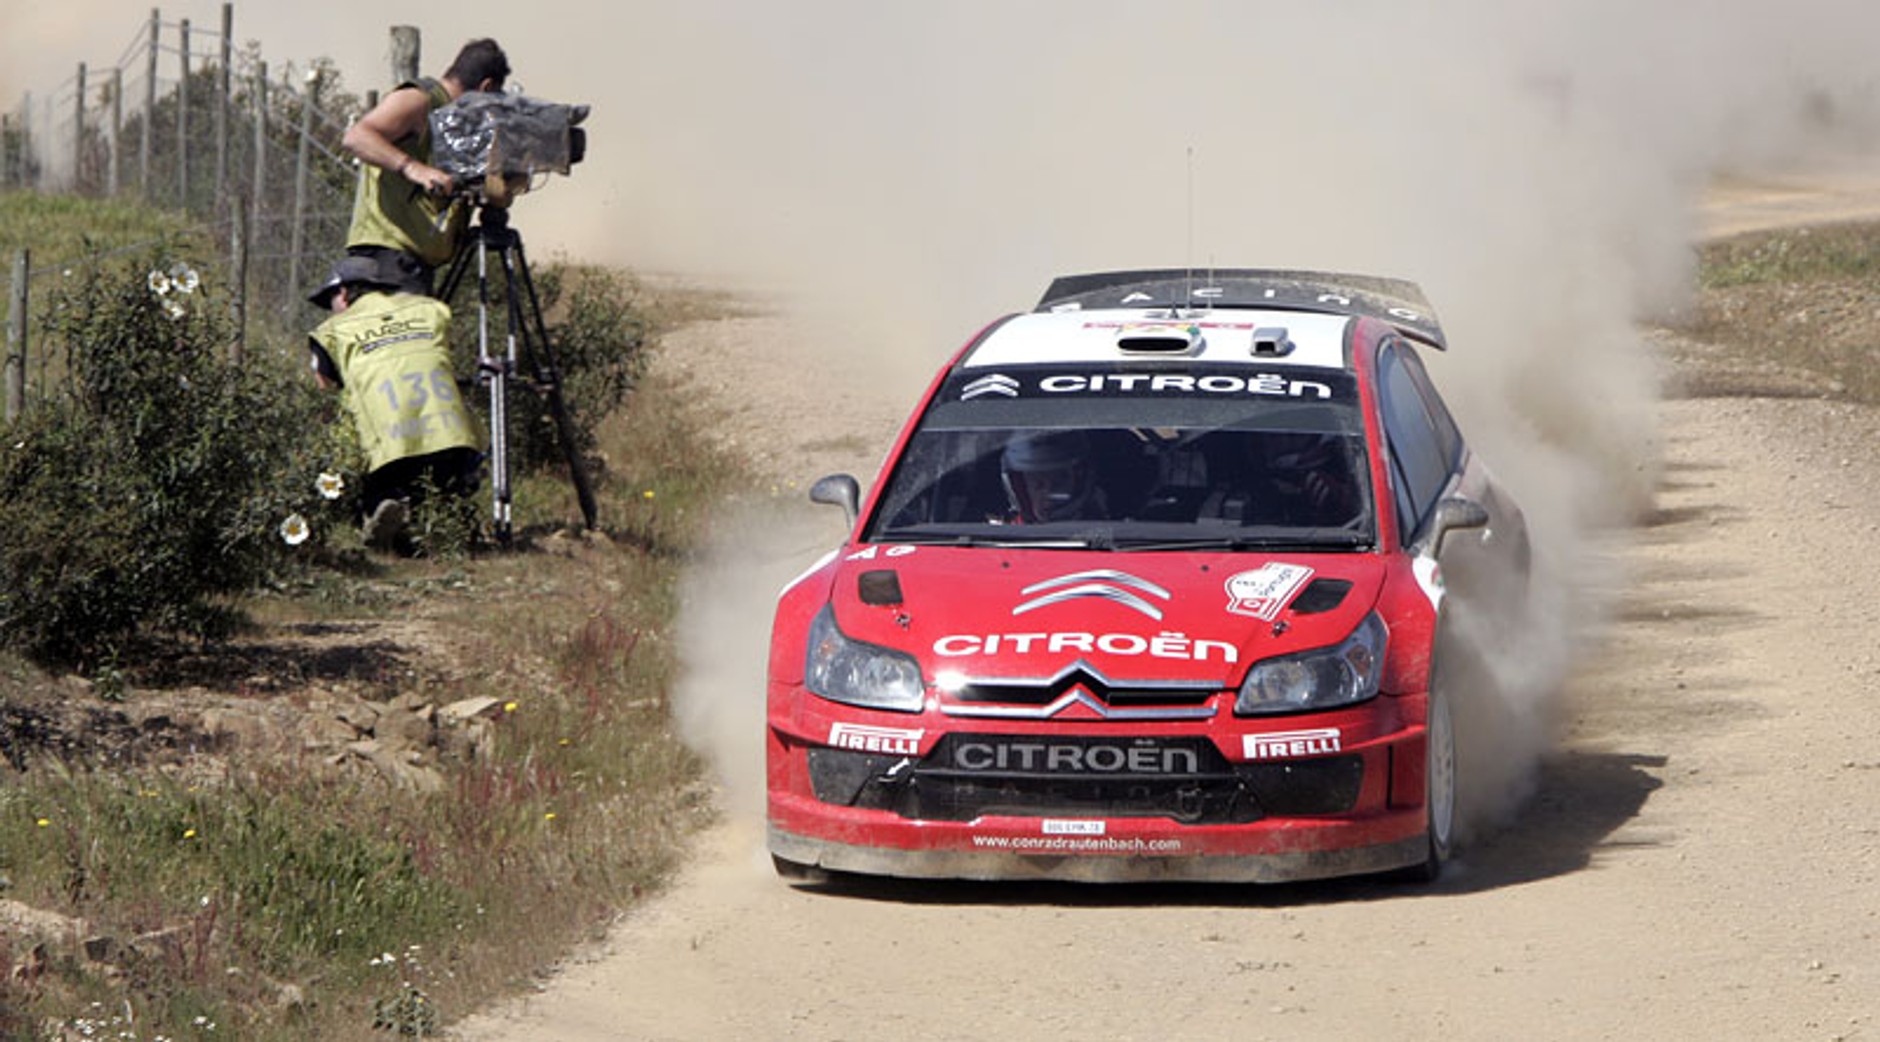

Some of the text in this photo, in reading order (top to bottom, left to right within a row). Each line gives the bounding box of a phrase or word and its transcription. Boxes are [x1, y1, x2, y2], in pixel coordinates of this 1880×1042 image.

[377, 368, 453, 411] 136
[827, 721, 925, 754] PIRELLI
[1243, 728, 1340, 758] PIRELLI
[973, 834, 1181, 850] www.conradrautenbach.com
